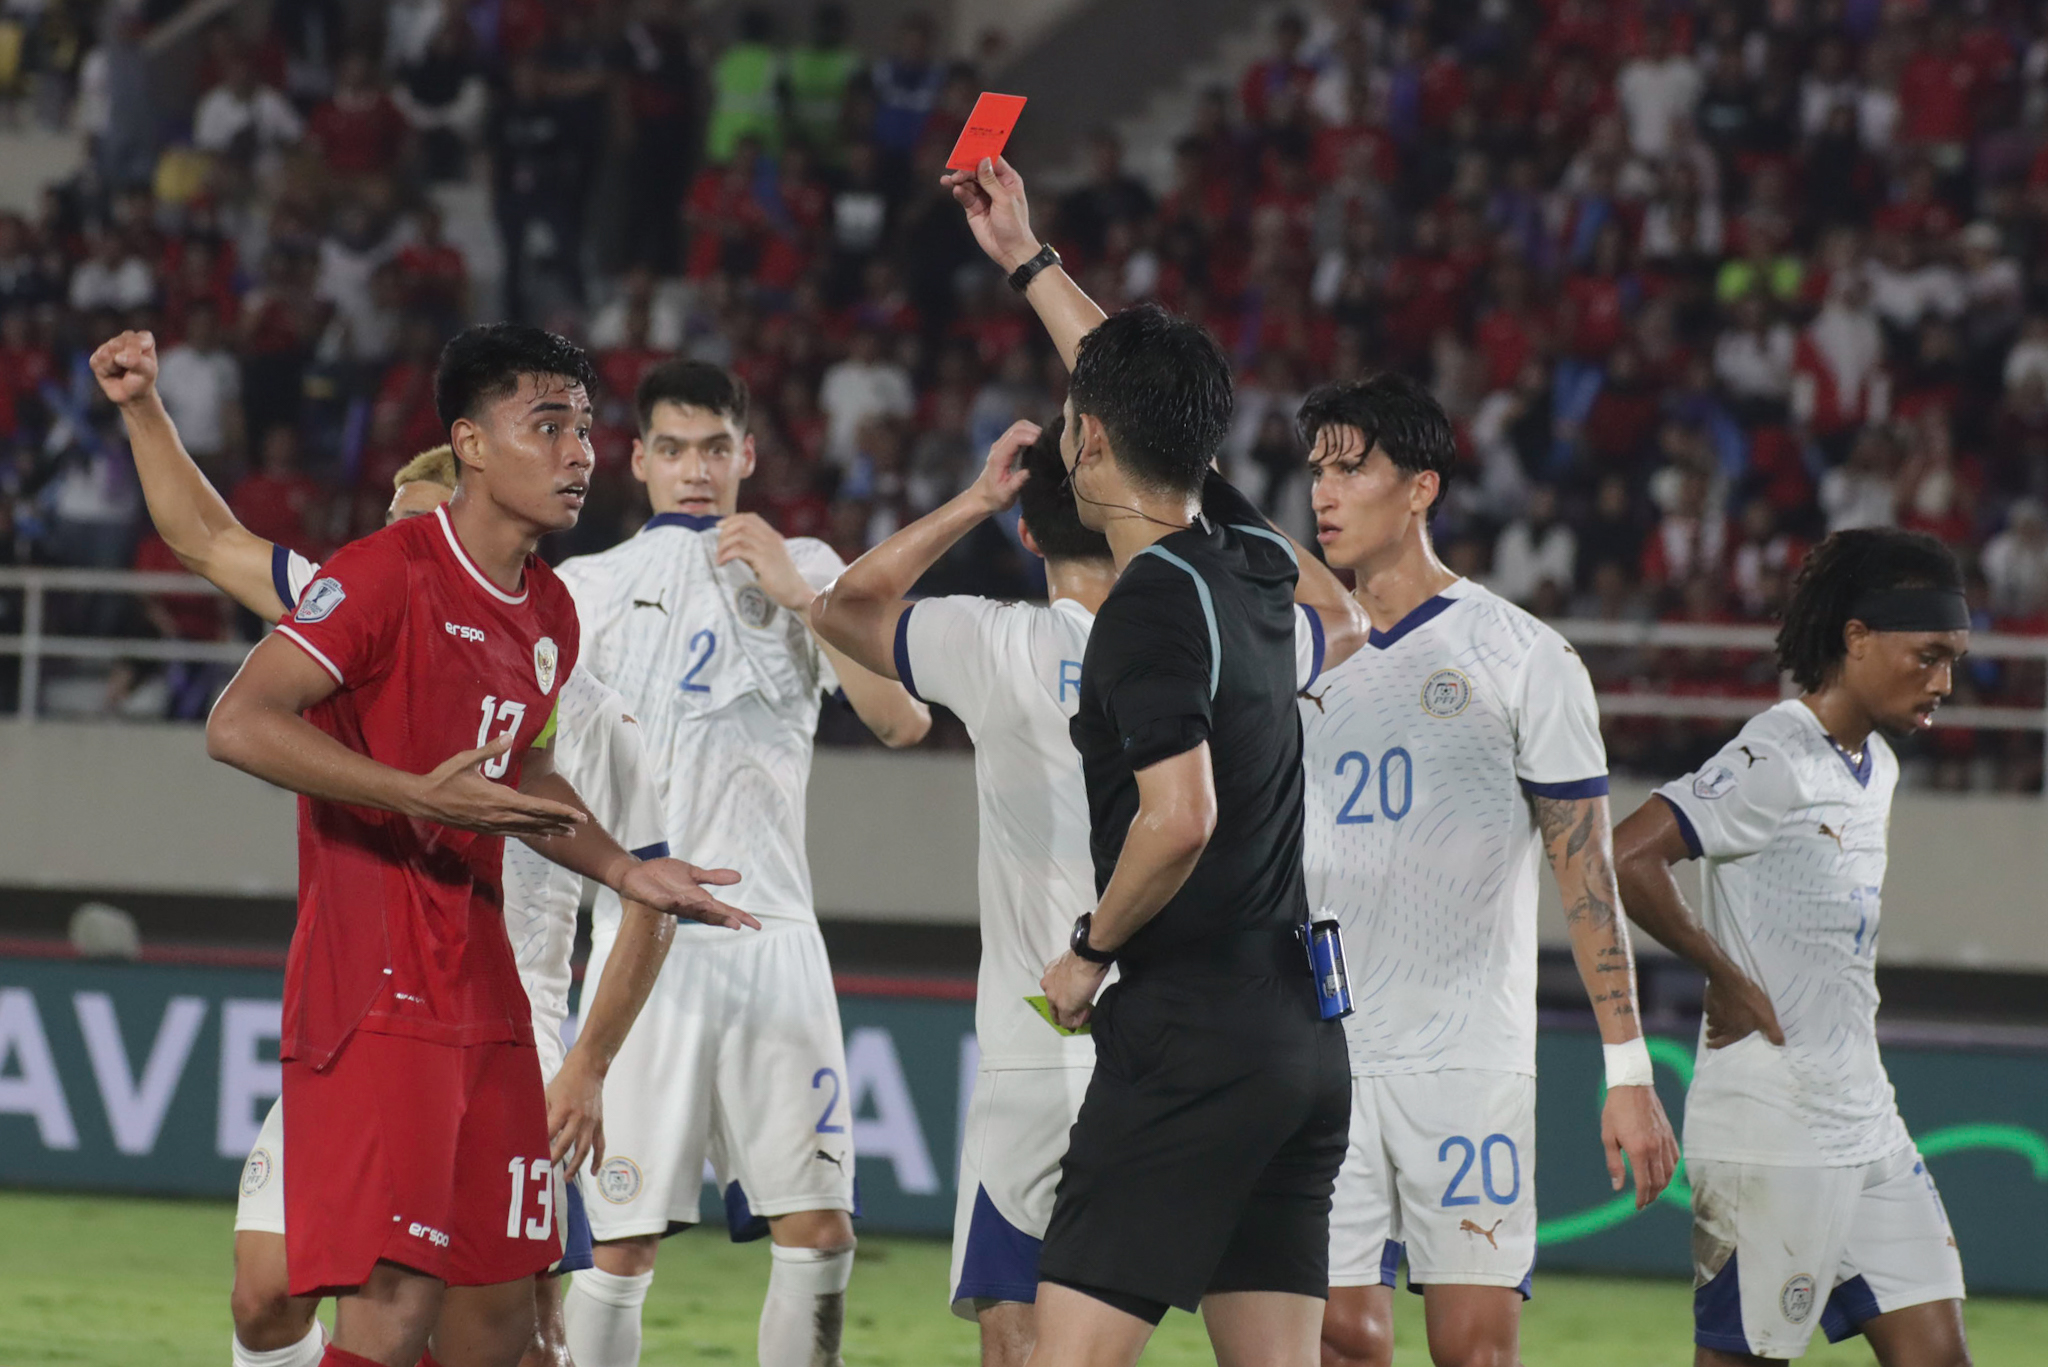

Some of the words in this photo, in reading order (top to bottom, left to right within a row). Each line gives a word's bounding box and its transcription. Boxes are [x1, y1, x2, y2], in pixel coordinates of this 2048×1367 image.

[445, 621, 485, 642] erspo
[680, 629, 716, 693] 2
[476, 694, 527, 779] 13
[1334, 746, 1413, 825] 20
[812, 1067, 845, 1134] 2
[507, 1156, 553, 1241] 13
[1438, 1134, 1520, 1207] 20
[408, 1222, 450, 1247] erspo
